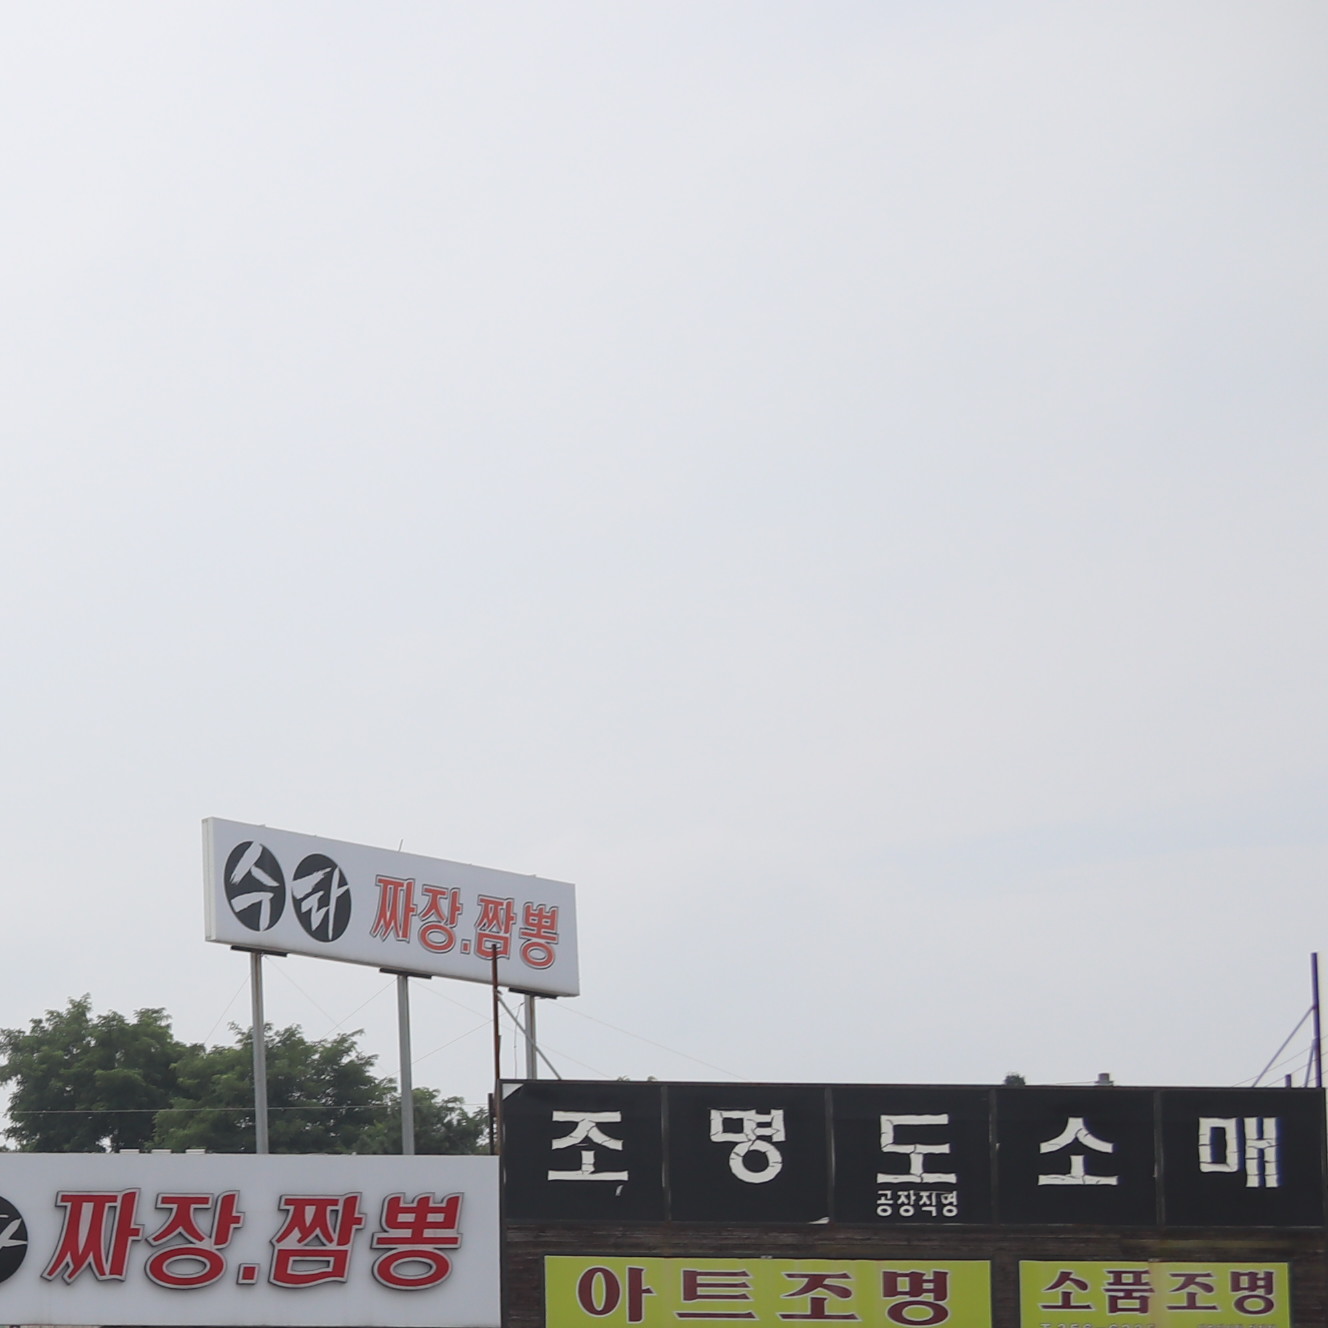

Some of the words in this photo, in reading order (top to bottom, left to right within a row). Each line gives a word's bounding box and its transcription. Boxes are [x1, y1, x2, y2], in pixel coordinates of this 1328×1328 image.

[876, 1190, 958, 1217] 공장직영
[43, 1188, 465, 1290] 짜장.짬뽕
[575, 1265, 954, 1327] 아트조명
[1038, 1268, 1277, 1318] 소품조명
